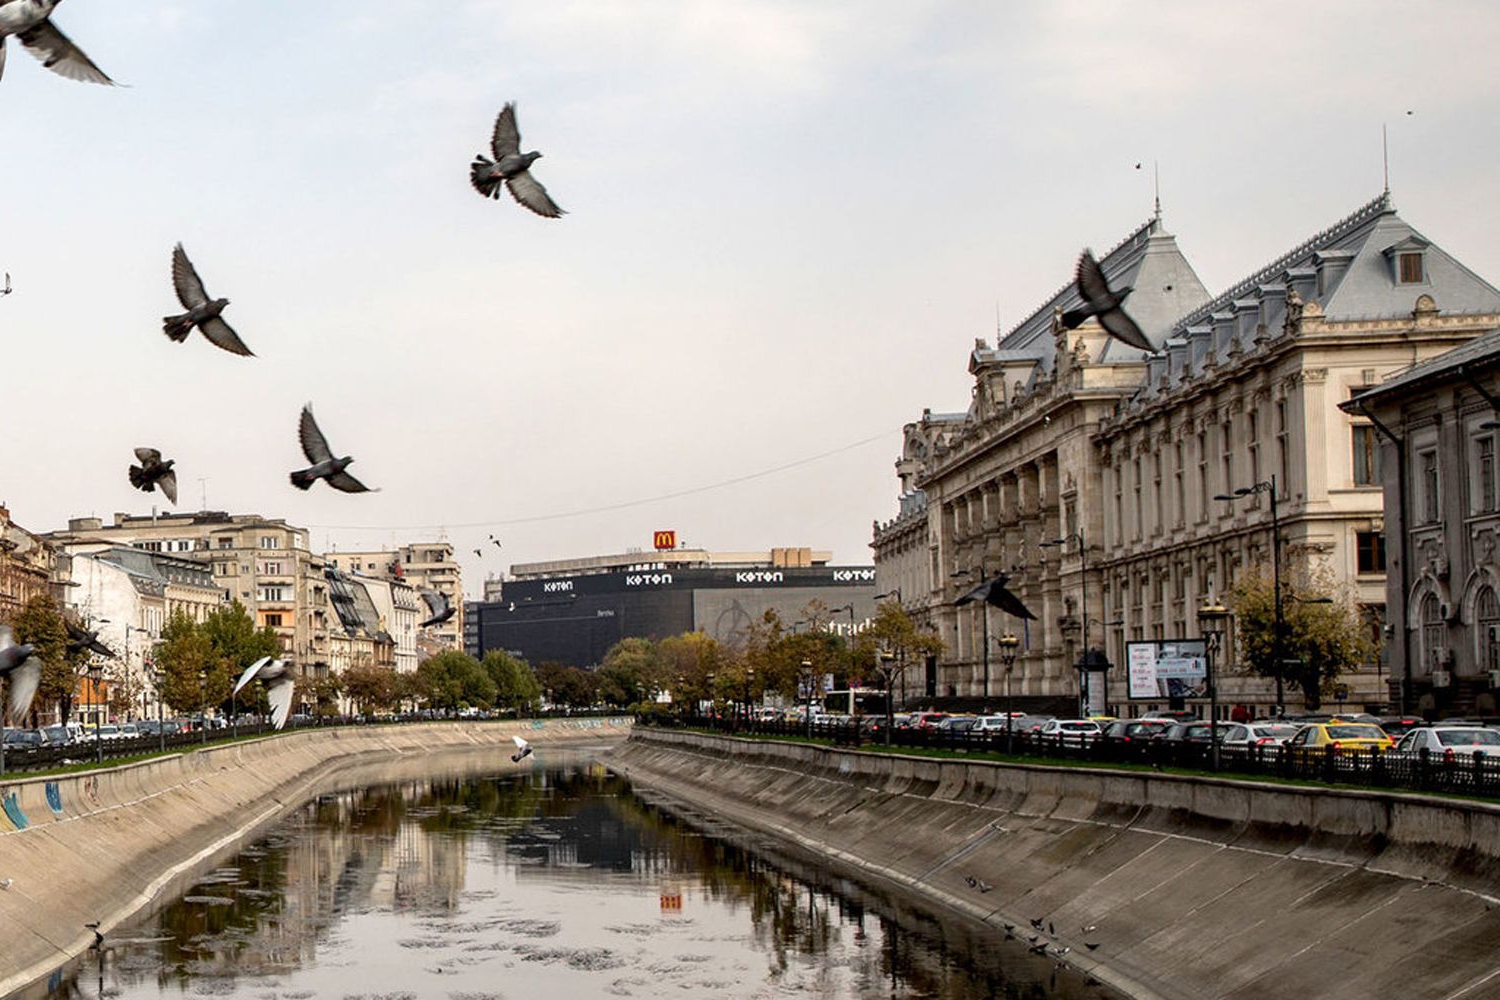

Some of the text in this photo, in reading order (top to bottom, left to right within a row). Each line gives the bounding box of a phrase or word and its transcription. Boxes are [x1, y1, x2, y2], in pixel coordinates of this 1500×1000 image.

[626, 574, 672, 585] KOTON
[736, 571, 783, 583] KOTON
[544, 581, 573, 593] KOTON
